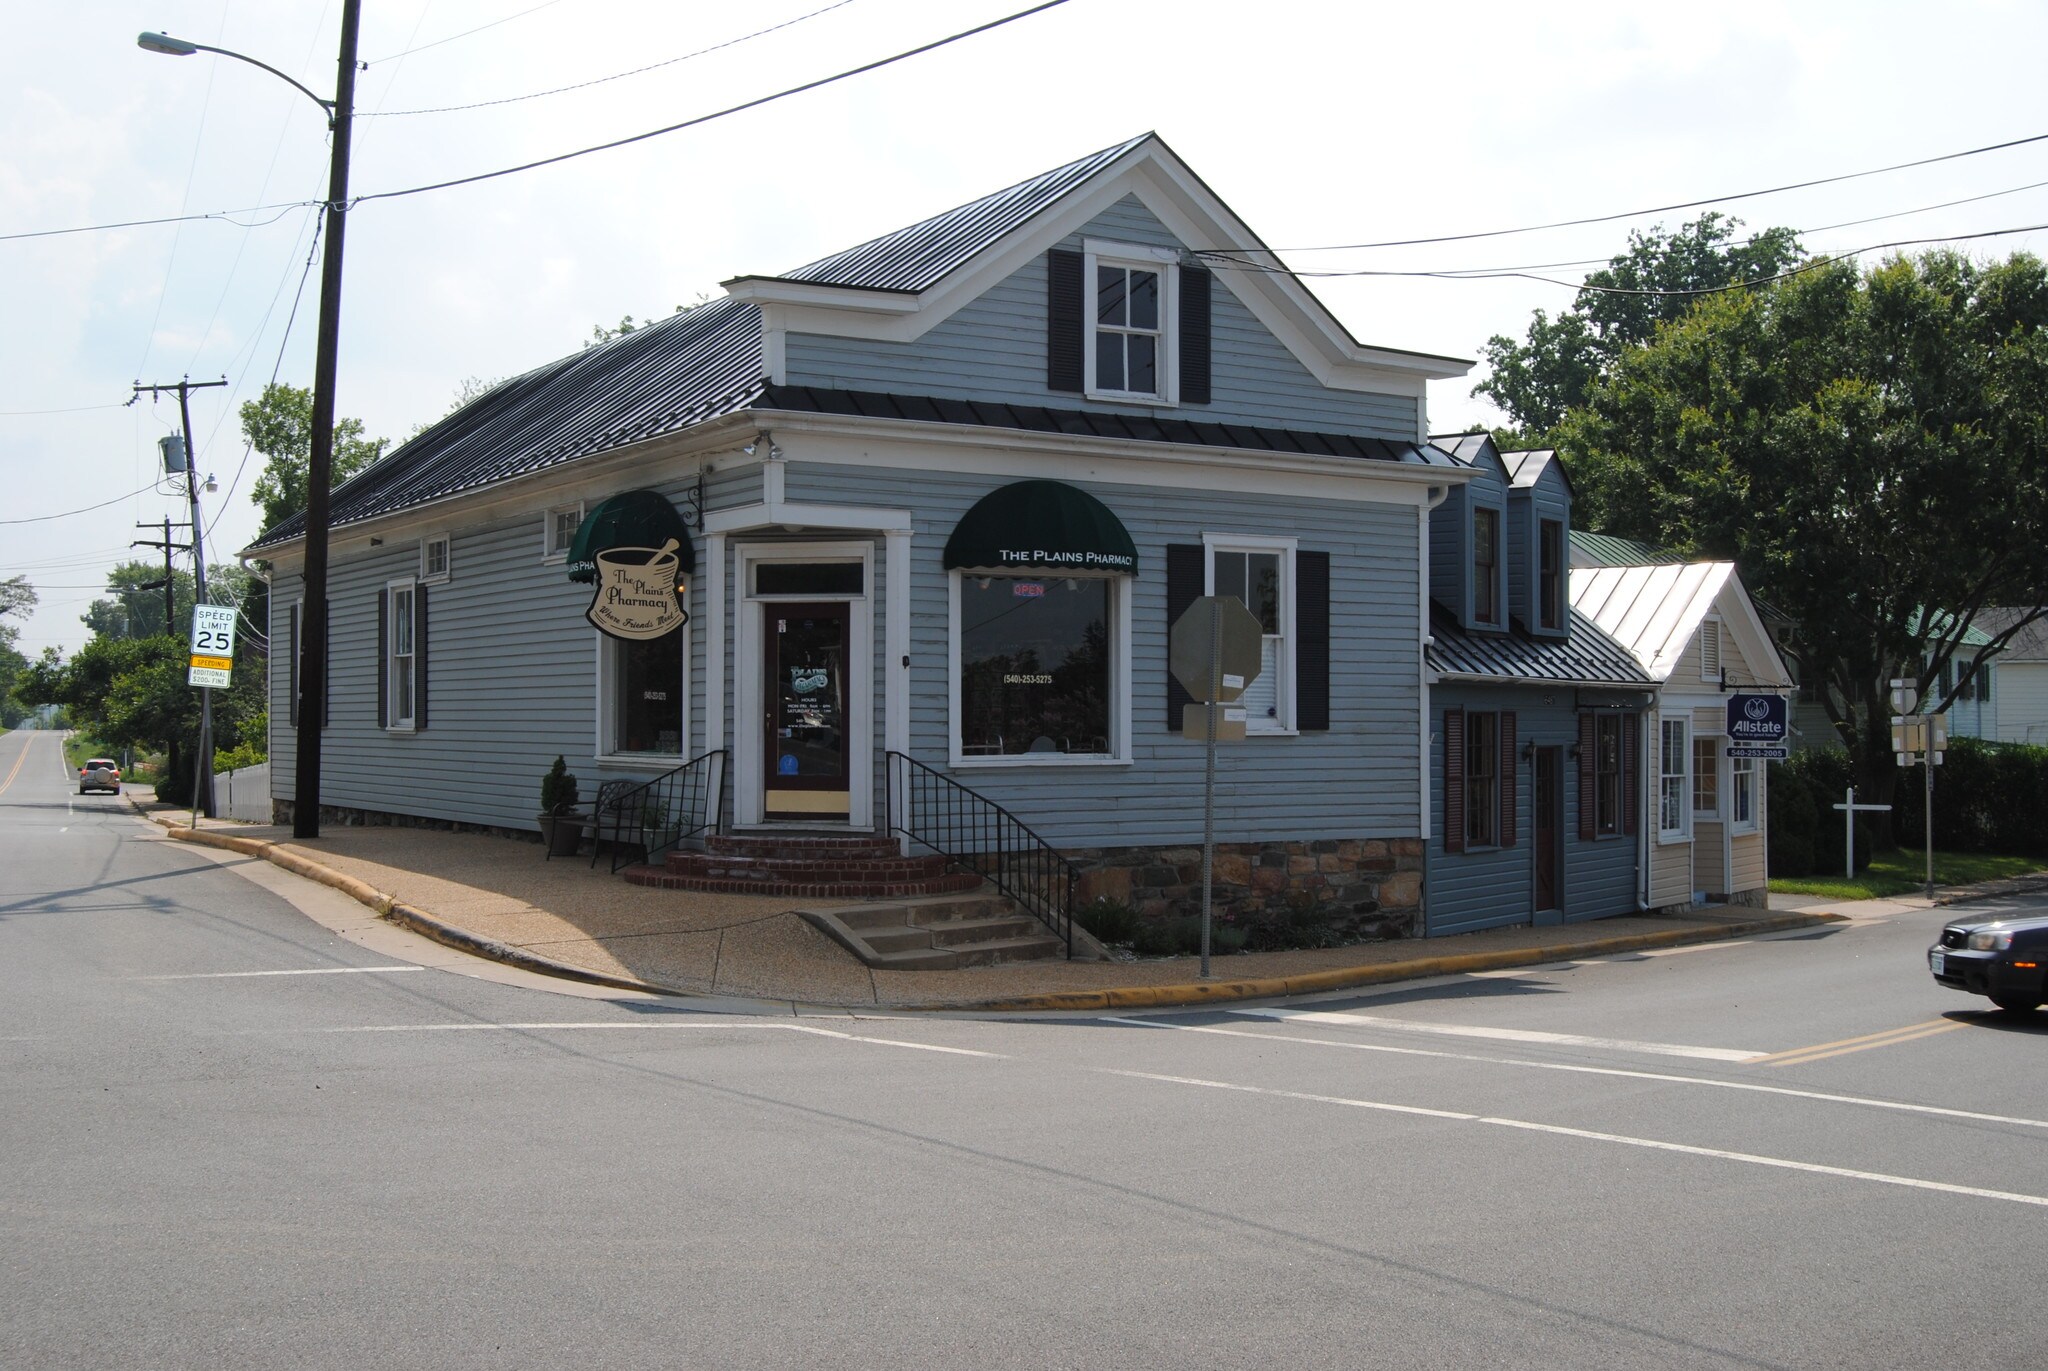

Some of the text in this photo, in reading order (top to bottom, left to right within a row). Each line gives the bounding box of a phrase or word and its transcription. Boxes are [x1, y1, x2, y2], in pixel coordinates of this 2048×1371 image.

[999, 550, 1133, 566] THE PLAINS PHARMACY
[613, 569, 633, 584] The
[632, 580, 664, 596] Plains
[1013, 584, 1044, 596] OPEN
[605, 585, 668, 614] Pharmacy
[198, 610, 233, 621] SPEED
[599, 605, 674, 629] Where Friends Meet
[201, 621, 229, 631] LIMIT
[196, 631, 229, 651] 25
[196, 659, 225, 668] SPEEDING
[193, 669, 226, 678] ADDITIONAL
[212, 677, 225, 685] FINE
[1733, 721, 1782, 733] Allstate
